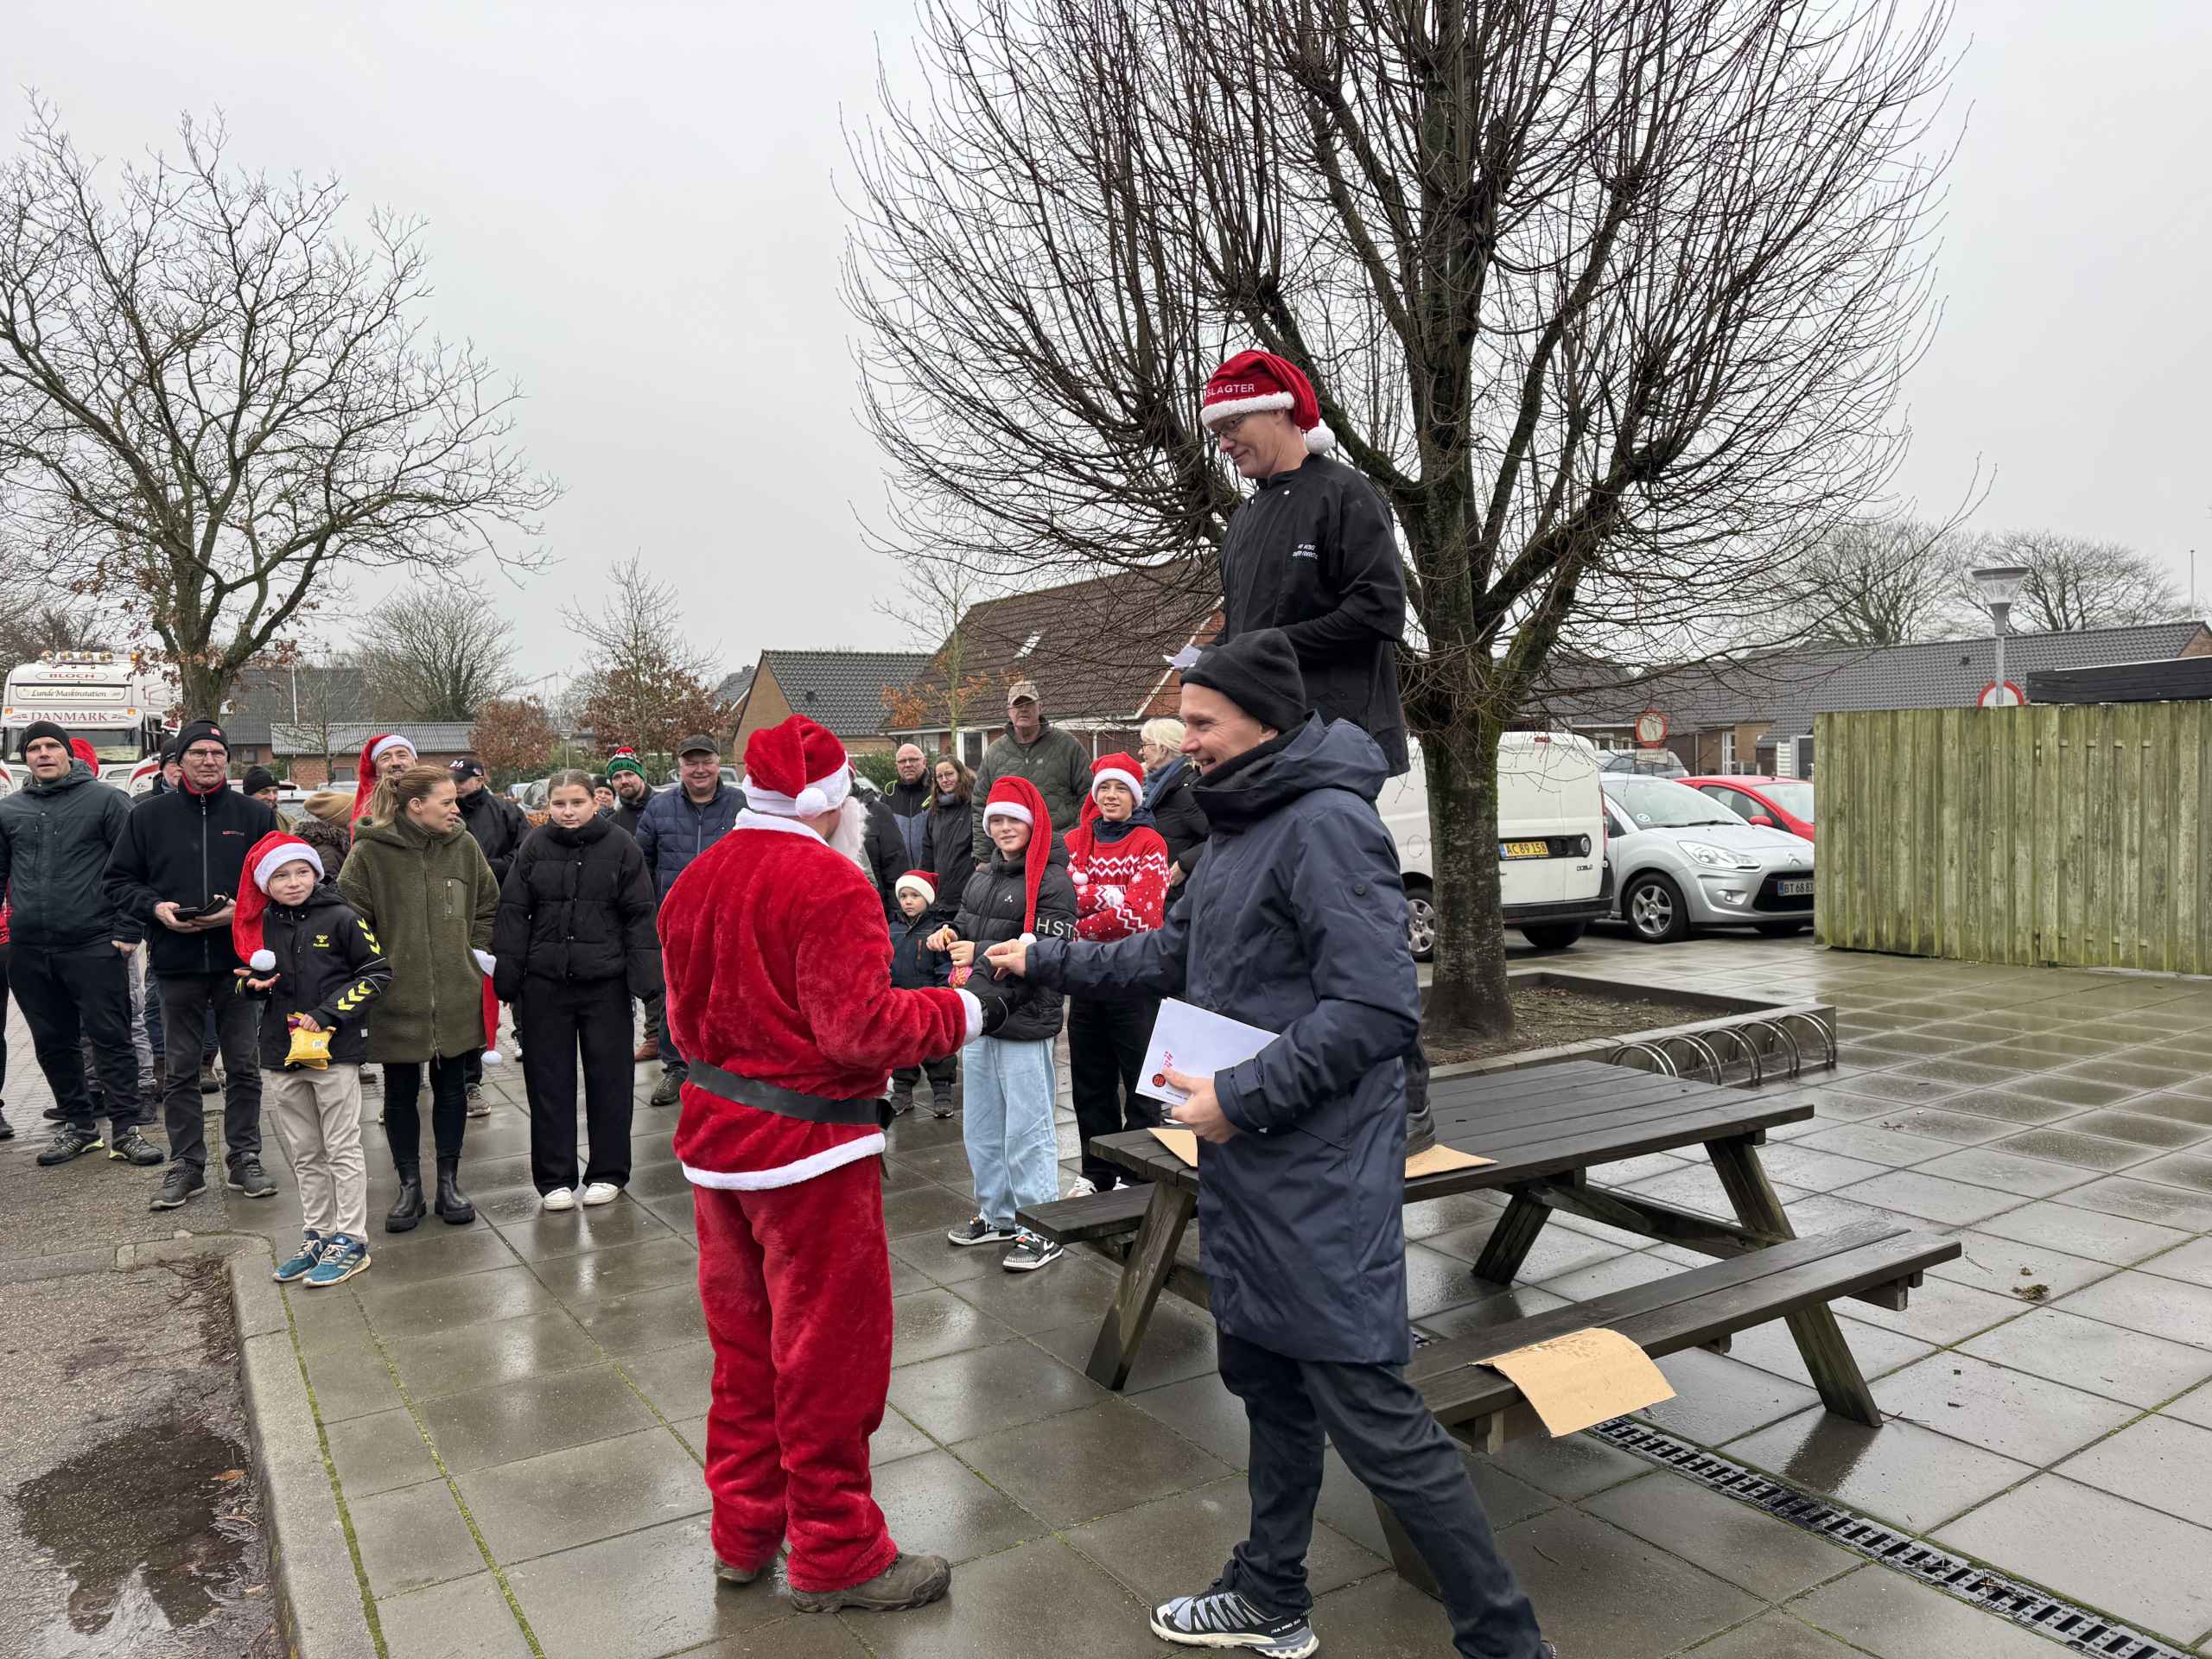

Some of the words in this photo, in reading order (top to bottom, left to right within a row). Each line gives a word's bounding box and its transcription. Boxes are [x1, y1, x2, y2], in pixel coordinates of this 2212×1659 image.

[1206, 384, 1255, 397] SLAGTER
[31, 712, 107, 721] DANMARK
[1506, 843, 1519, 855] AC
[1520, 843, 1530, 854] 89
[1533, 842, 1548, 853] 158
